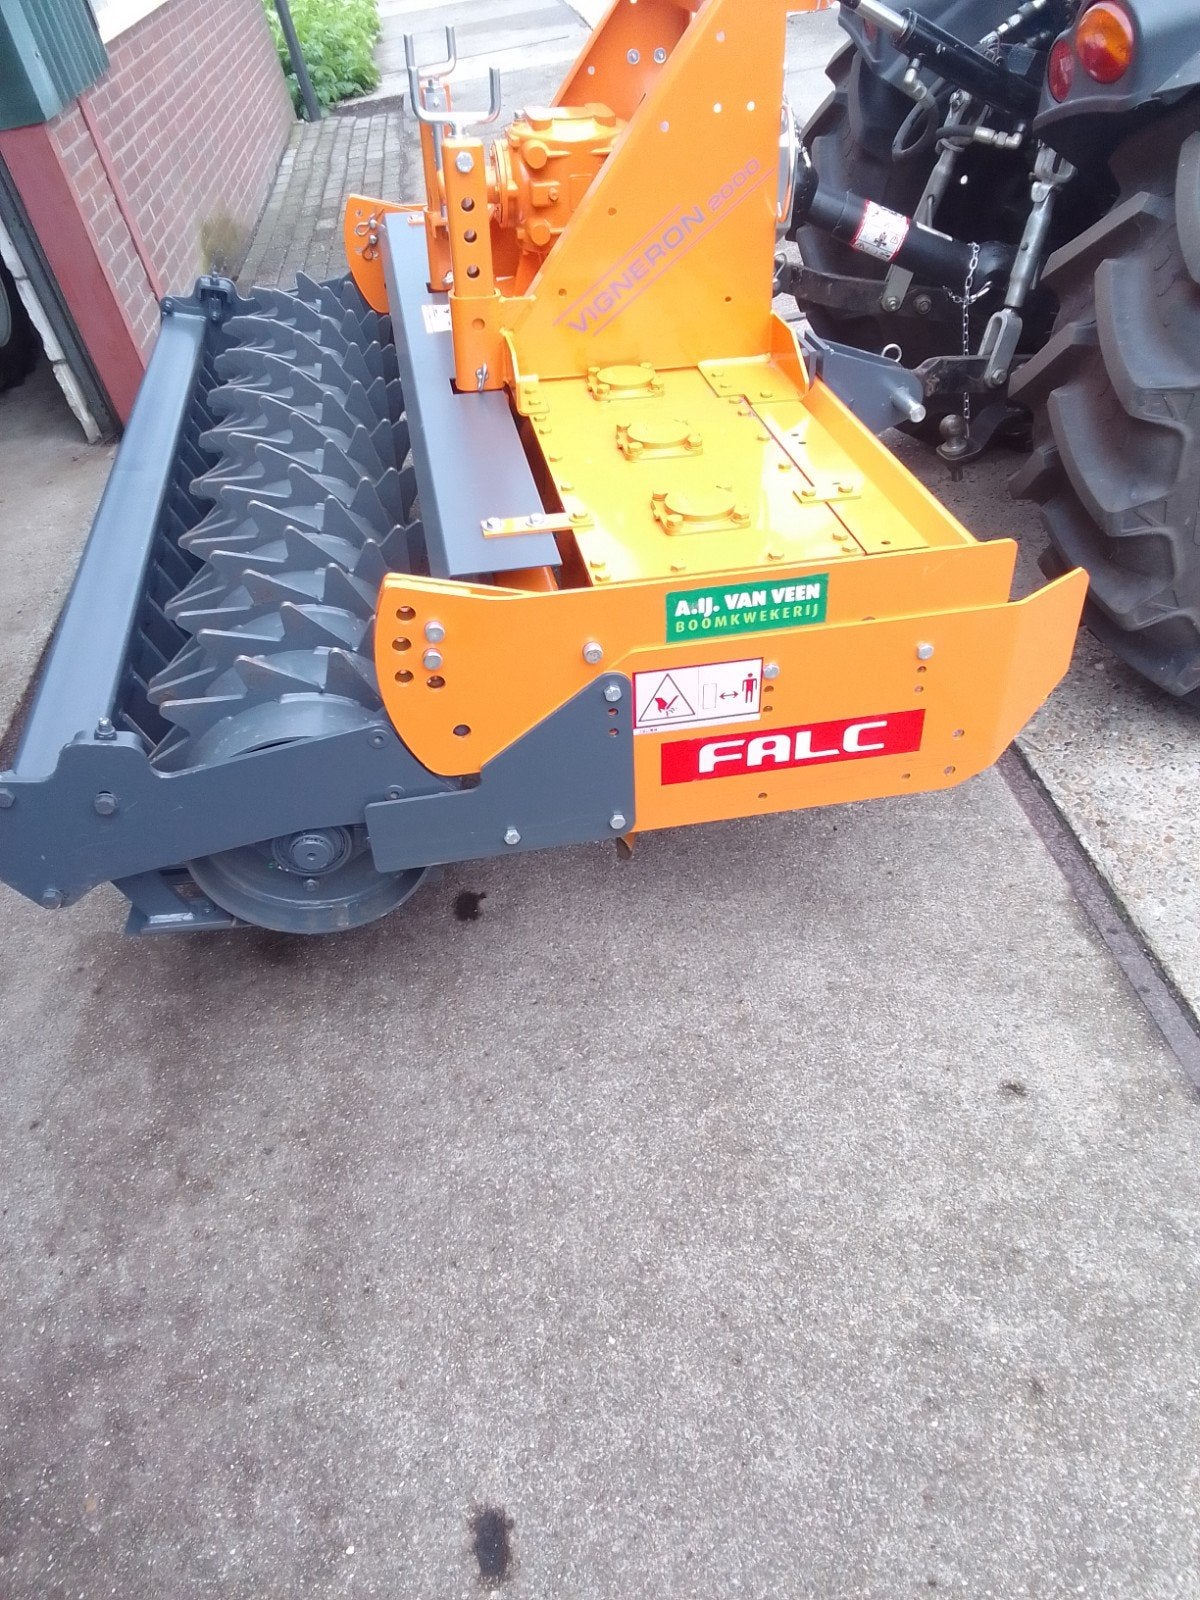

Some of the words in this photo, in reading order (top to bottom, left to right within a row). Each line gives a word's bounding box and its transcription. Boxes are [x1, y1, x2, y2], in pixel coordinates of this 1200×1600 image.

[567, 205, 705, 333] VIGNERON
[708, 158, 760, 212] 2000
[724, 590, 766, 610] VAN
[772, 583, 820, 603] VEEN
[676, 603, 818, 633] BOOMKWEKERIJ
[698, 721, 887, 773] FALC
